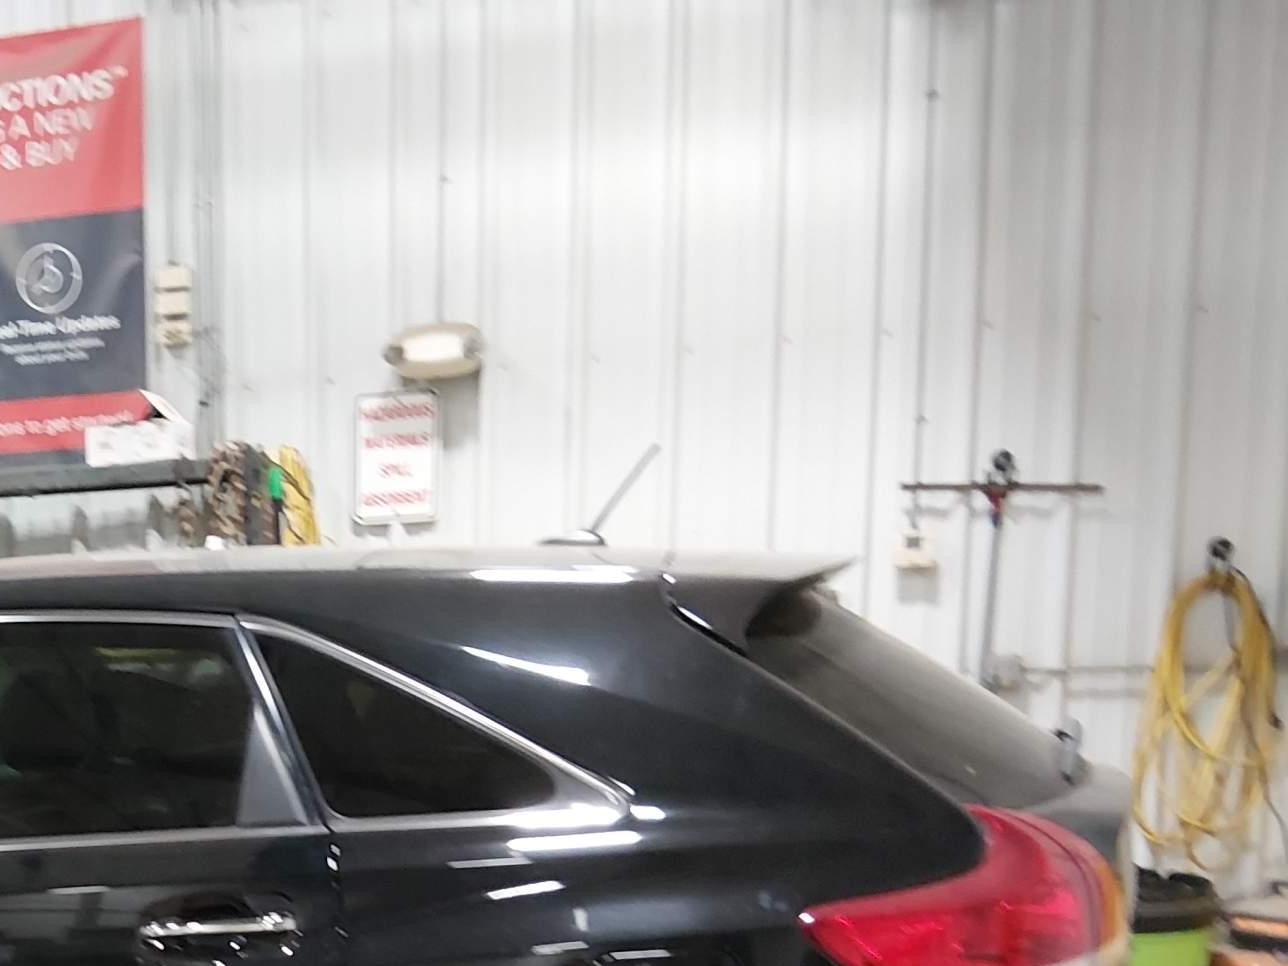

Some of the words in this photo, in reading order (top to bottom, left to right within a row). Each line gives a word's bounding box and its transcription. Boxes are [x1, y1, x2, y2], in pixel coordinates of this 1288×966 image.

[8, 114, 31, 141] A
[33, 104, 95, 136] NEW
[24, 135, 79, 167] BUY
